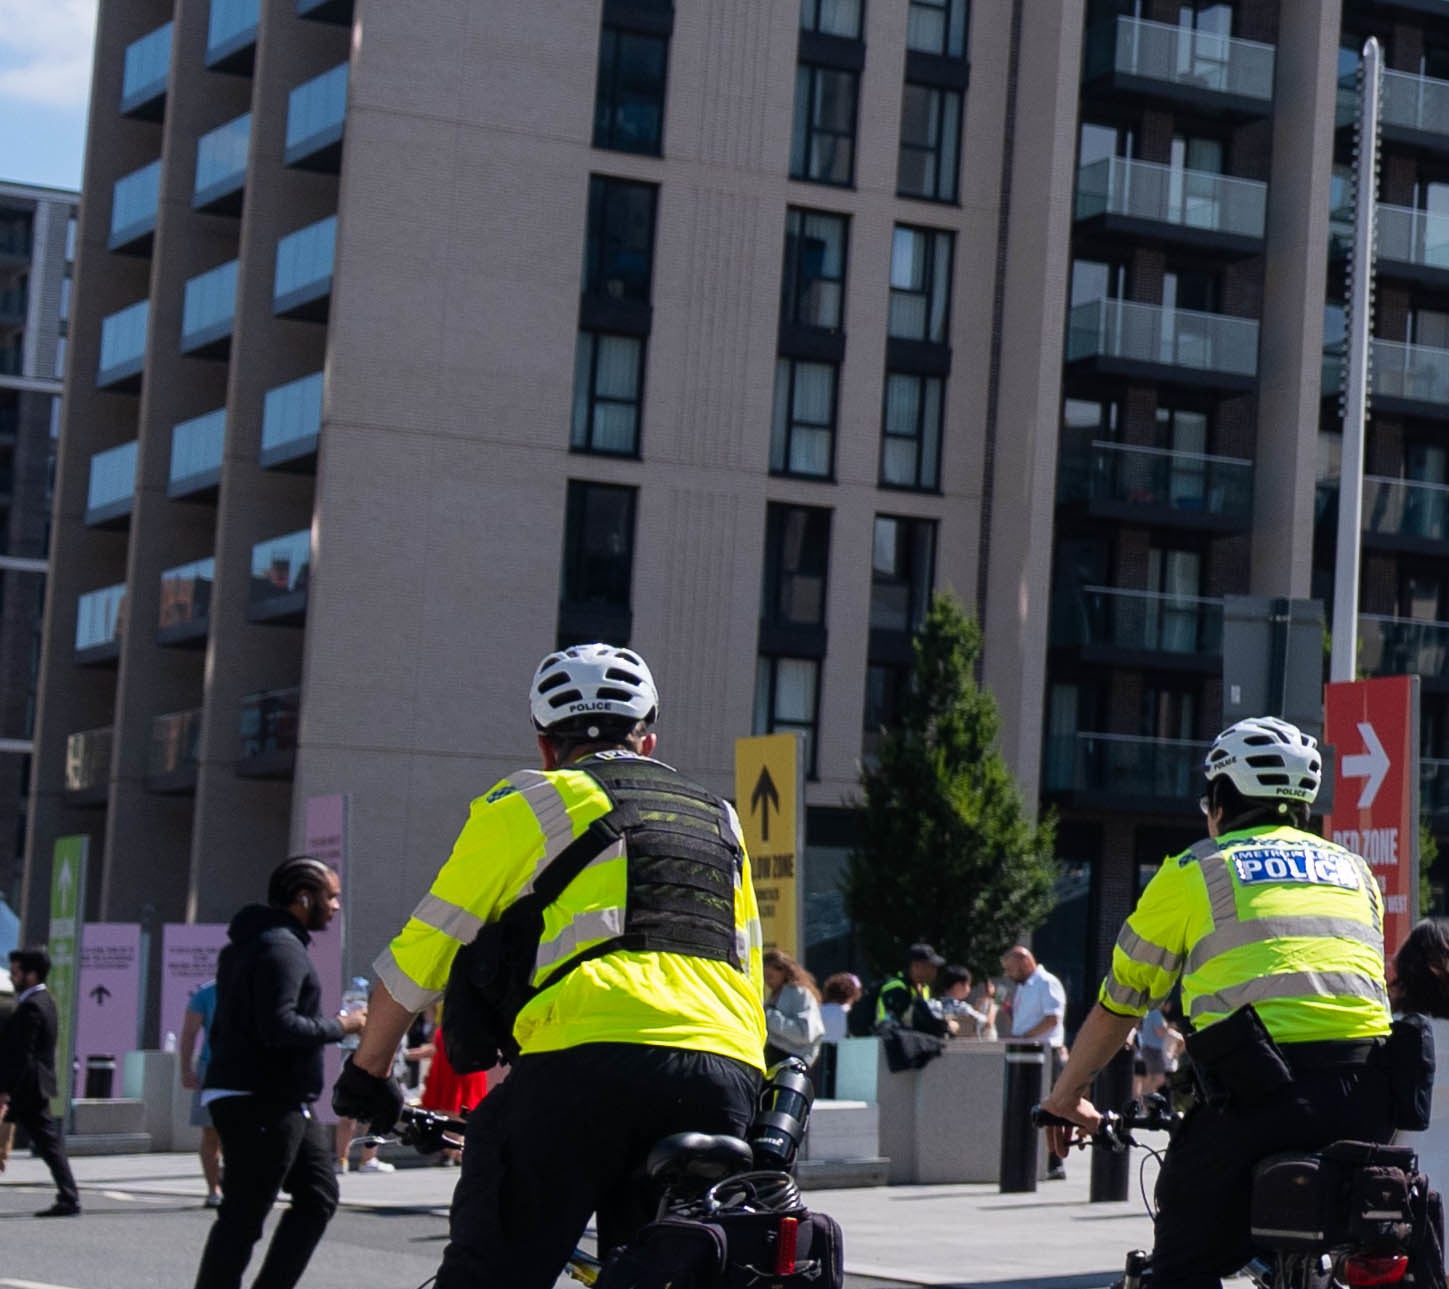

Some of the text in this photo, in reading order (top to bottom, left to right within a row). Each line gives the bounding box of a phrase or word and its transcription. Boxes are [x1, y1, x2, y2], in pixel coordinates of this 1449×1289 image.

[568, 701, 613, 713] POLICE
[1276, 787, 1307, 798] POLICE
[1361, 827, 1399, 866] ZONE
[772, 853, 795, 880] ZONE
